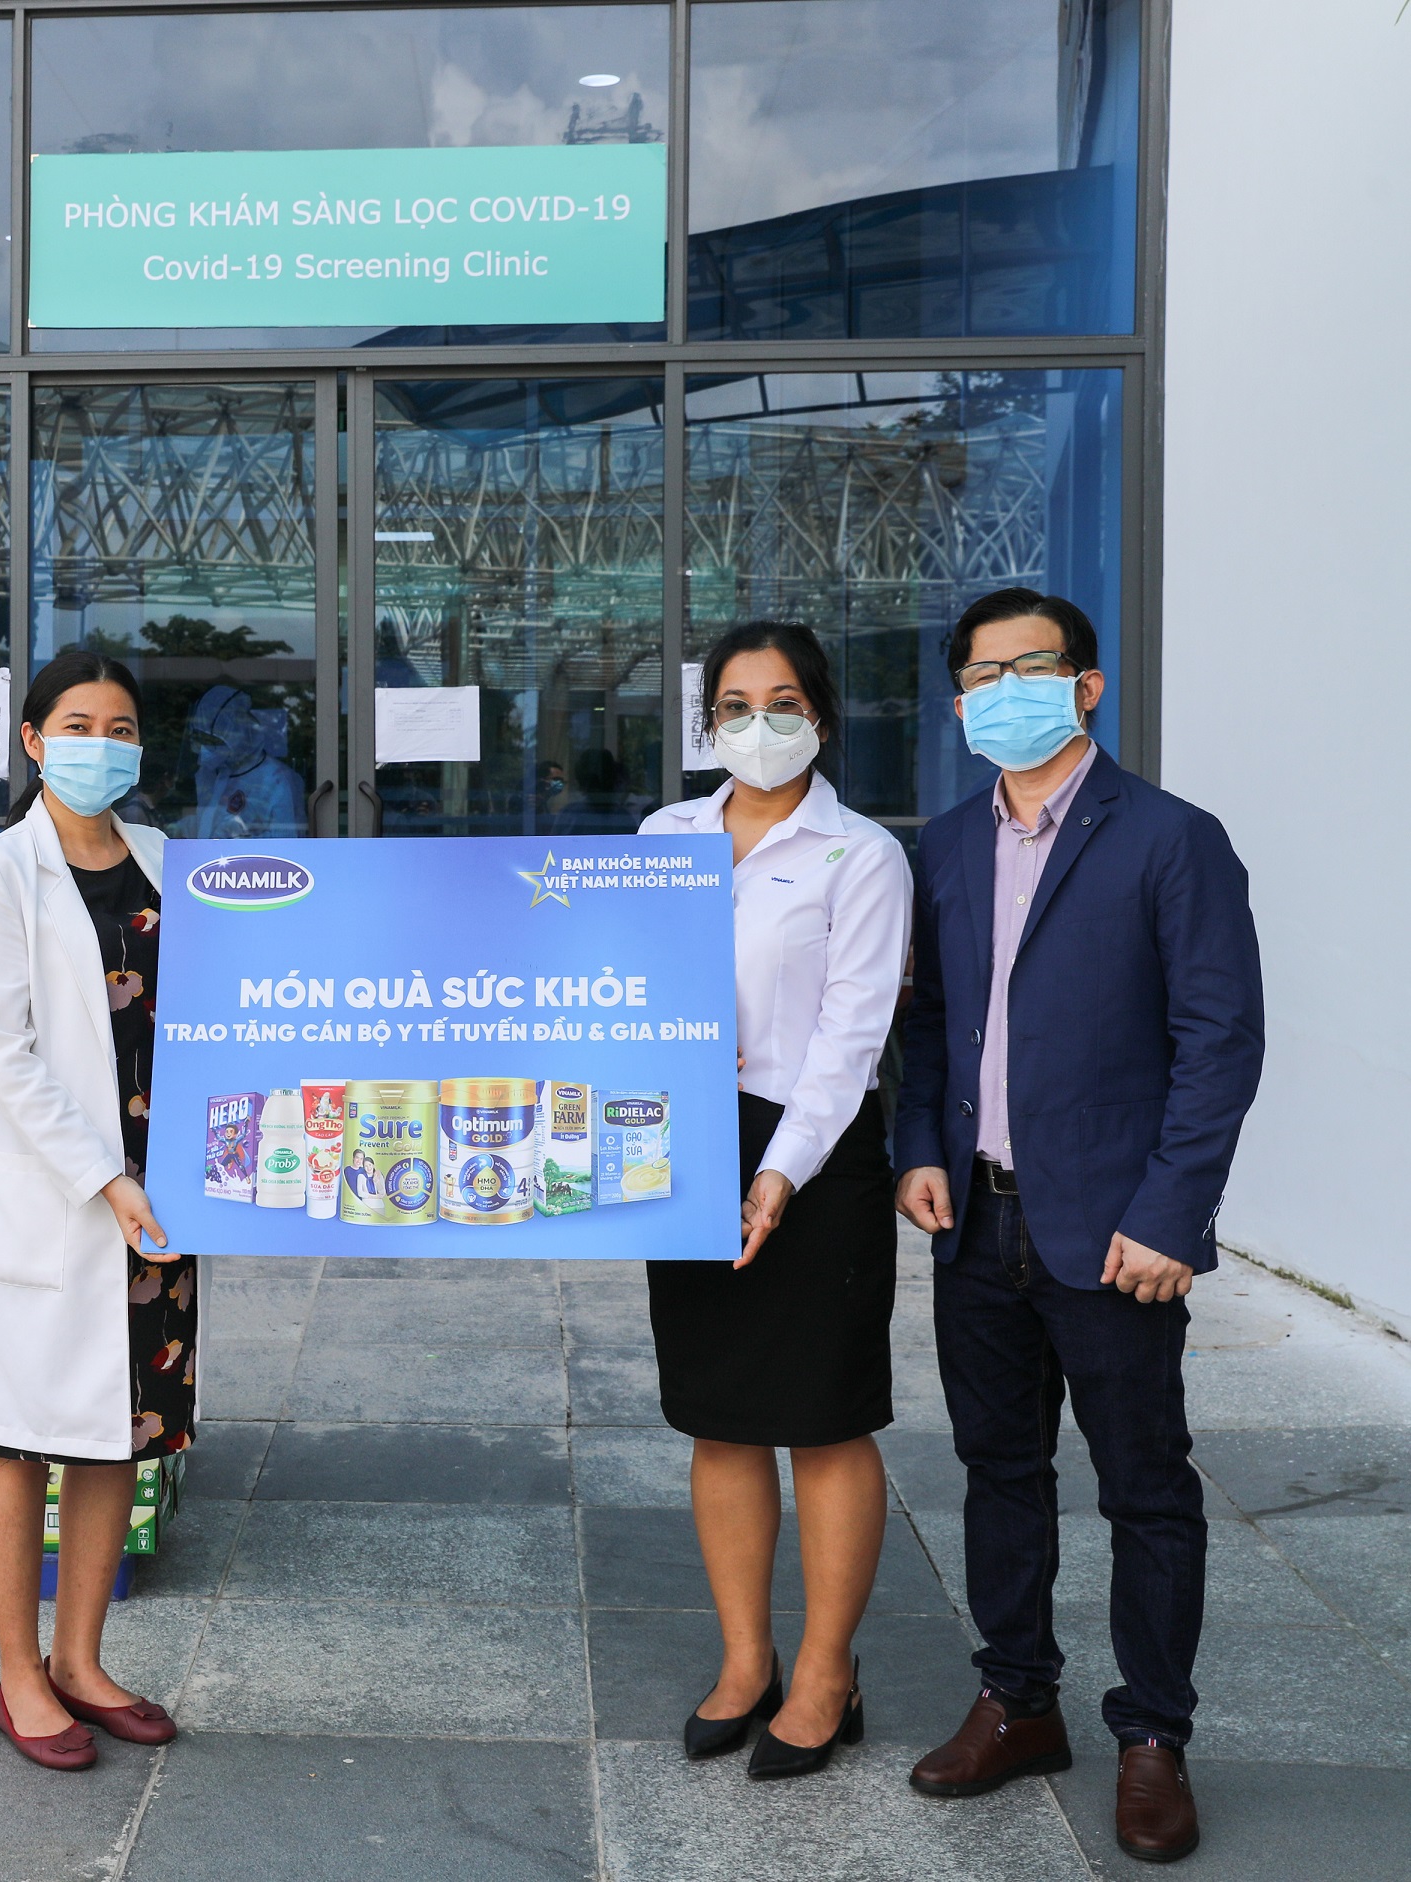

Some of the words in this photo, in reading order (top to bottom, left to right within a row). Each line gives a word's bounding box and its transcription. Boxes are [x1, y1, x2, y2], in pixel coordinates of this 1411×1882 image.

[63, 194, 176, 228] PHÒNG
[189, 193, 279, 227] KHÁM
[291, 192, 382, 226] SÀNG
[394, 198, 457, 229] LỌC
[469, 194, 631, 223] COVID-19
[143, 253, 283, 282] Covid-19
[295, 253, 451, 284] Screening
[463, 250, 549, 278] Clinic
[562, 858, 594, 874] BẠN
[597, 854, 641, 870] KHỎE
[645, 856, 692, 873] MẠNH
[200, 870, 302, 891] VINAMILK
[543, 873, 579, 893] VIỆT
[582, 876, 619, 888] NAM
[622, 871, 668, 888] KHỎE
[671, 874, 720, 891] MẠNH
[240, 970, 334, 1009] MÓN
[344, 970, 433, 1009] QUÀ
[442, 969, 525, 1008] SỨC
[535, 966, 646, 1007] KHỎE
[164, 1023, 228, 1042] TRAO
[232, 1019, 296, 1048] TẶNG
[301, 1019, 351, 1042] CÁN
[357, 1019, 391, 1048] BỘ
[397, 1024, 414, 1042] Y
[418, 1017, 445, 1042] TẾ
[450, 1016, 527, 1042] TUYẾN
[533, 1016, 582, 1041] ĐẦU
[588, 1023, 605, 1042] &
[610, 1022, 654, 1041] GIA
[659, 1017, 719, 1041] ĐÌNH
[209, 1096, 250, 1129] HERO
[558, 1103, 581, 1111] GREEN
[359, 1113, 423, 1140] Sure
[452, 1116, 523, 1136] Optimum
[553, 1111, 585, 1125] FARM
[359, 1140, 389, 1148] Prevent
[392, 1140, 423, 1152] Gold
[472, 1134, 502, 1143] GOLD
